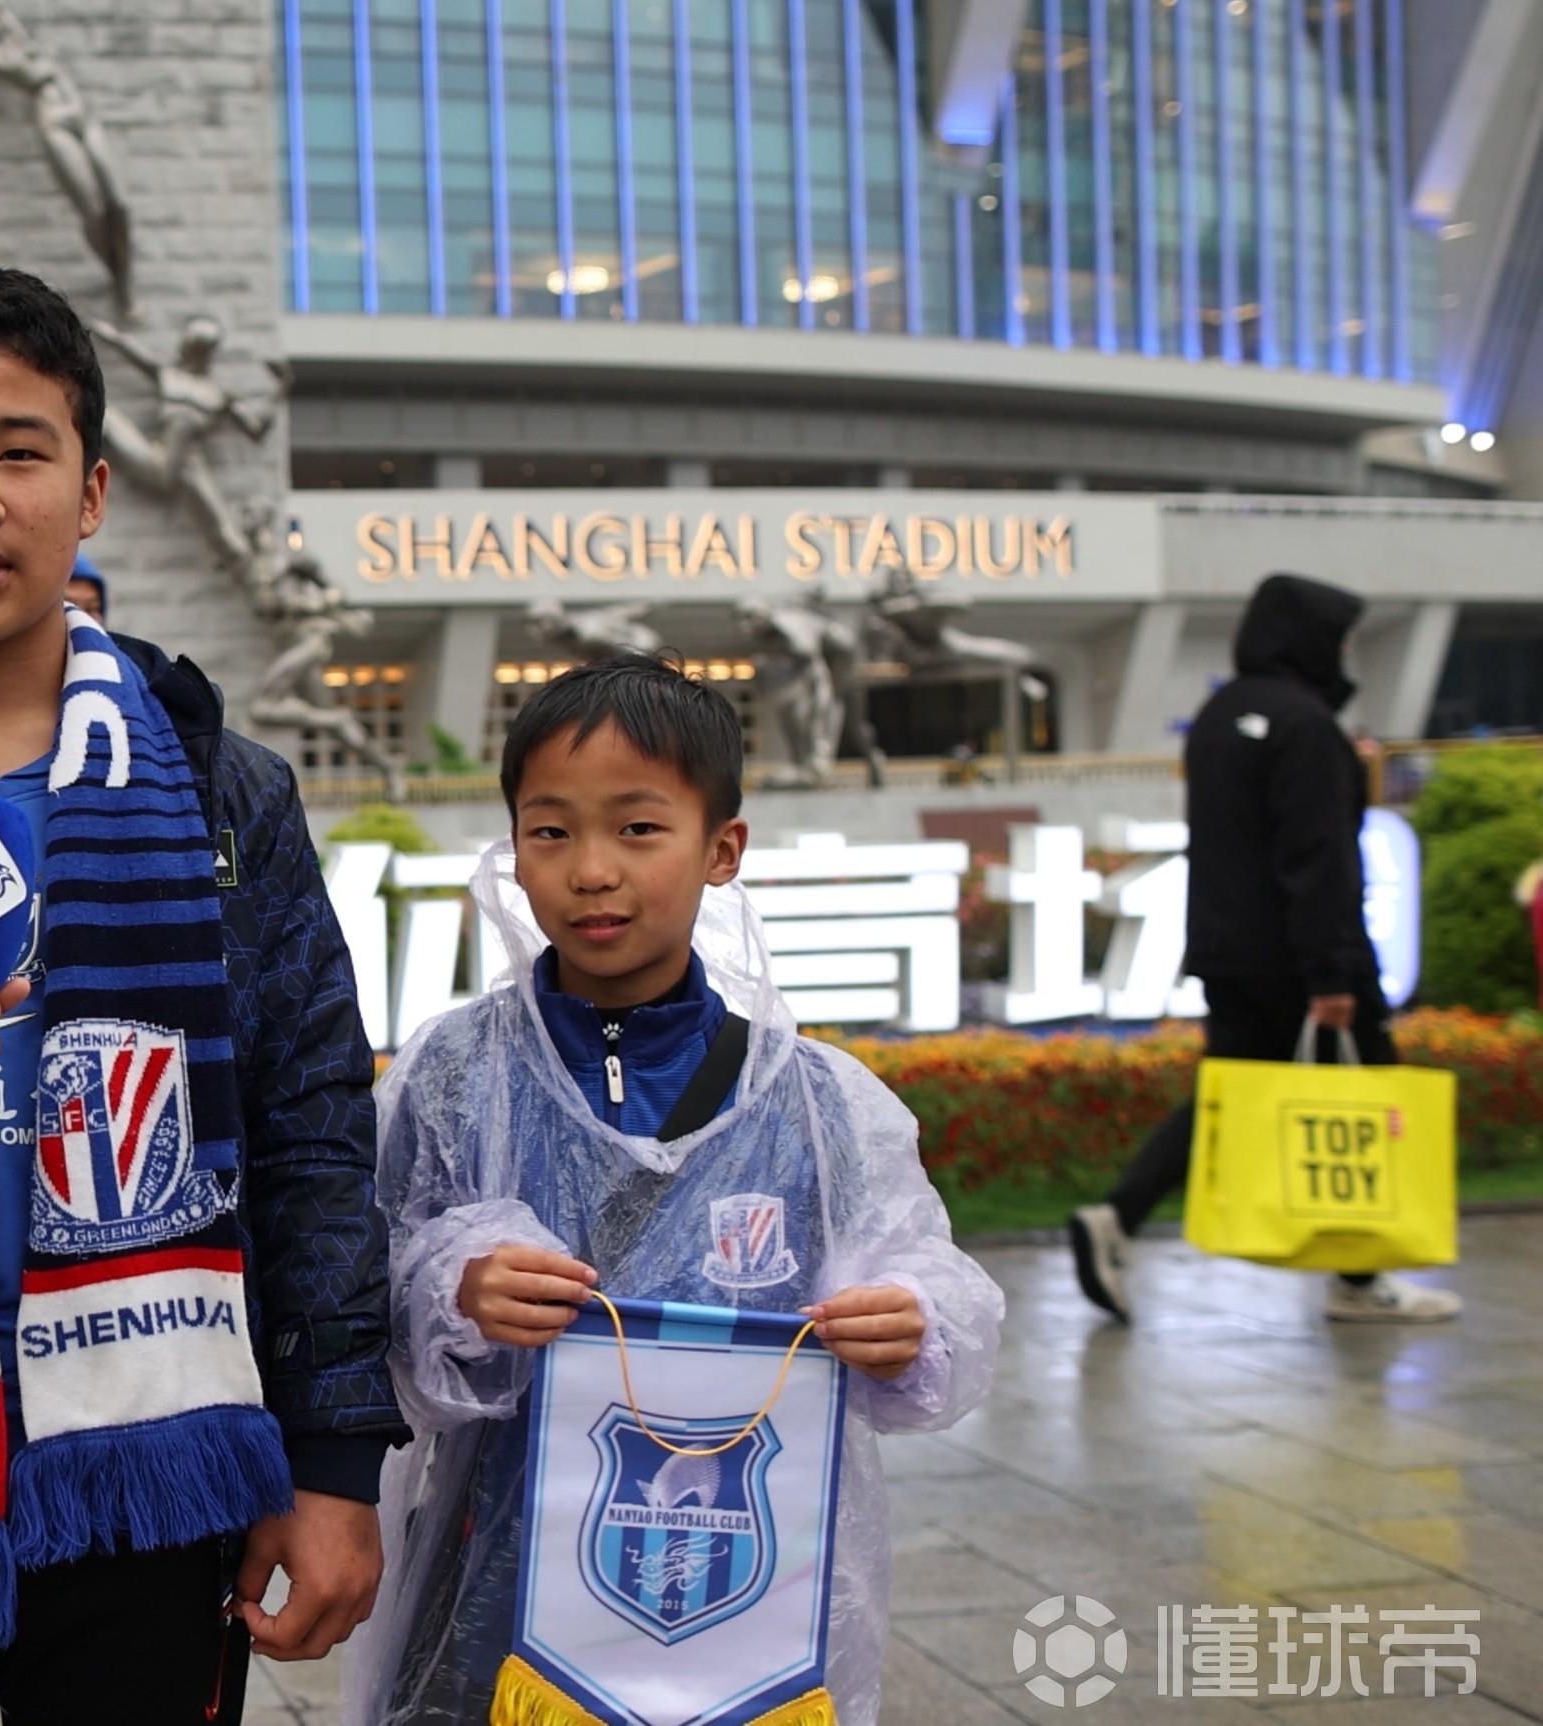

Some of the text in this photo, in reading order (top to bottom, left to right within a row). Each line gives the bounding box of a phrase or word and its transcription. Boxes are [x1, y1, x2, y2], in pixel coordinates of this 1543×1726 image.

[357, 511, 1076, 582] SHANGHAI STADIUM
[59, 1031, 138, 1048] SHENHUA
[1298, 1115, 1376, 1155] TOP
[1300, 1161, 1380, 1203] TOY
[74, 1217, 171, 1243] GREENLAND
[21, 1296, 237, 1359] SHENHUA
[608, 1508, 752, 1531] NANYAO FOOTBALL CLUB
